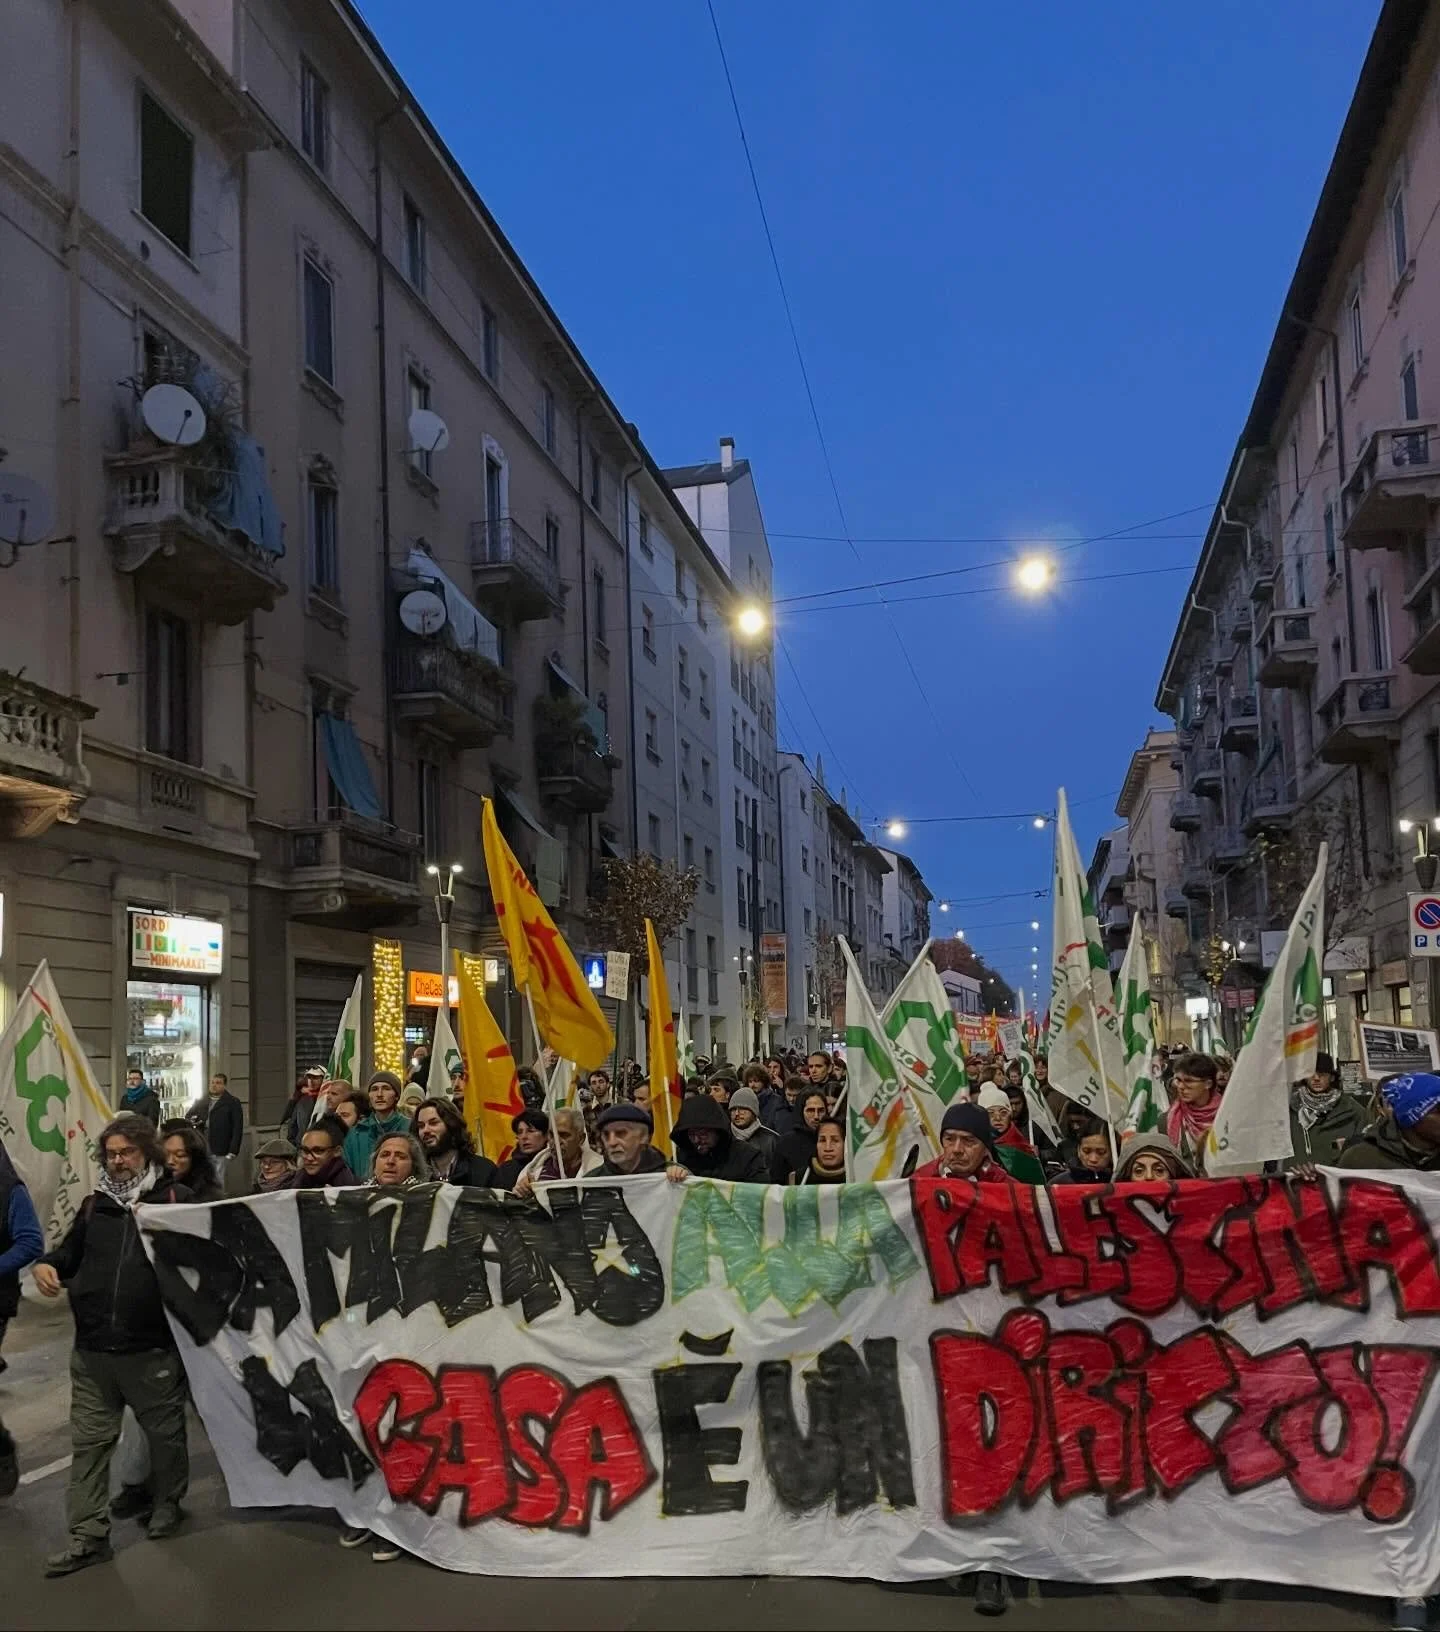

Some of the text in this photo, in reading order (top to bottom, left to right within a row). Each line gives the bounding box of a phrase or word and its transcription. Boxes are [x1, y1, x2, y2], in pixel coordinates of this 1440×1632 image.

[150, 952, 206, 969] MINIMARKET
[415, 977, 444, 996] CheCas
[141, 1175, 1440, 1347] DA MILANO ALLA PALESTINA
[353, 1357, 658, 1537] CASA
[756, 1334, 917, 1515] UN
